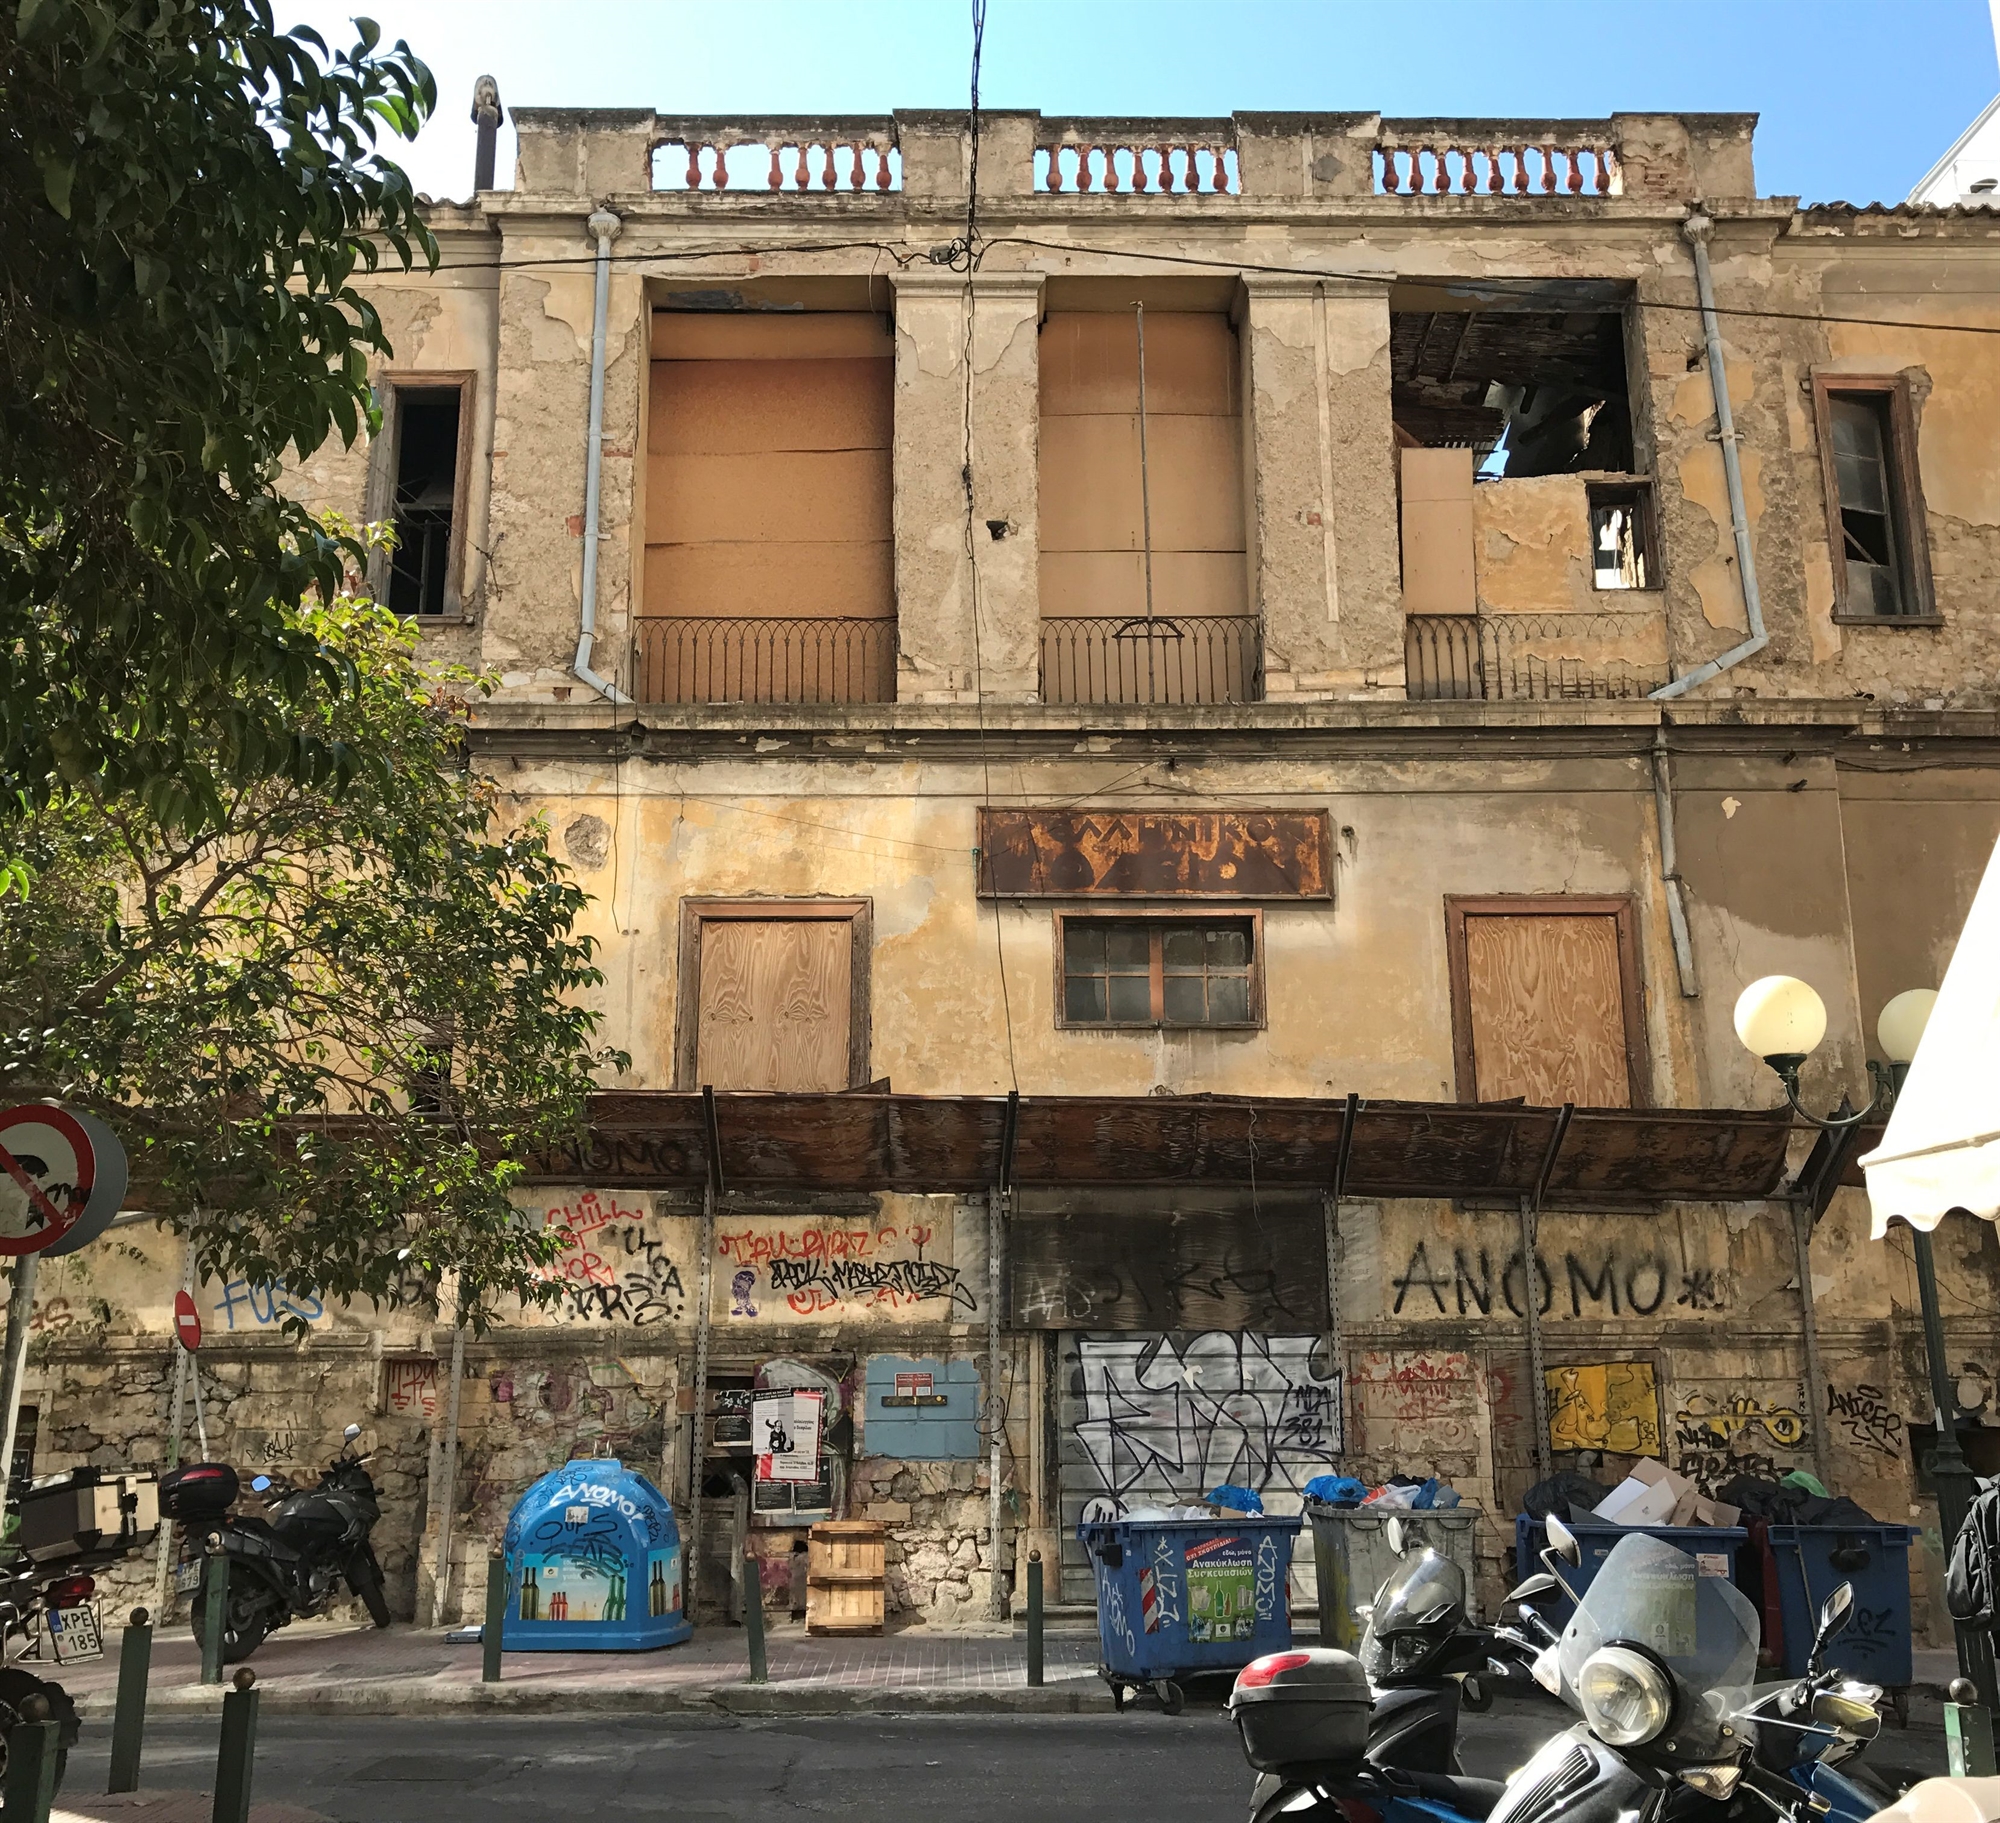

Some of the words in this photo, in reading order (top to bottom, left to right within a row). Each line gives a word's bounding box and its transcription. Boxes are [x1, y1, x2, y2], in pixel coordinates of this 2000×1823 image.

[1192, 1558, 1253, 1569] Ανακύκλωση
[1187, 1567, 1253, 1578] Συσκευασιών
[68, 1632, 97, 1652] 185
